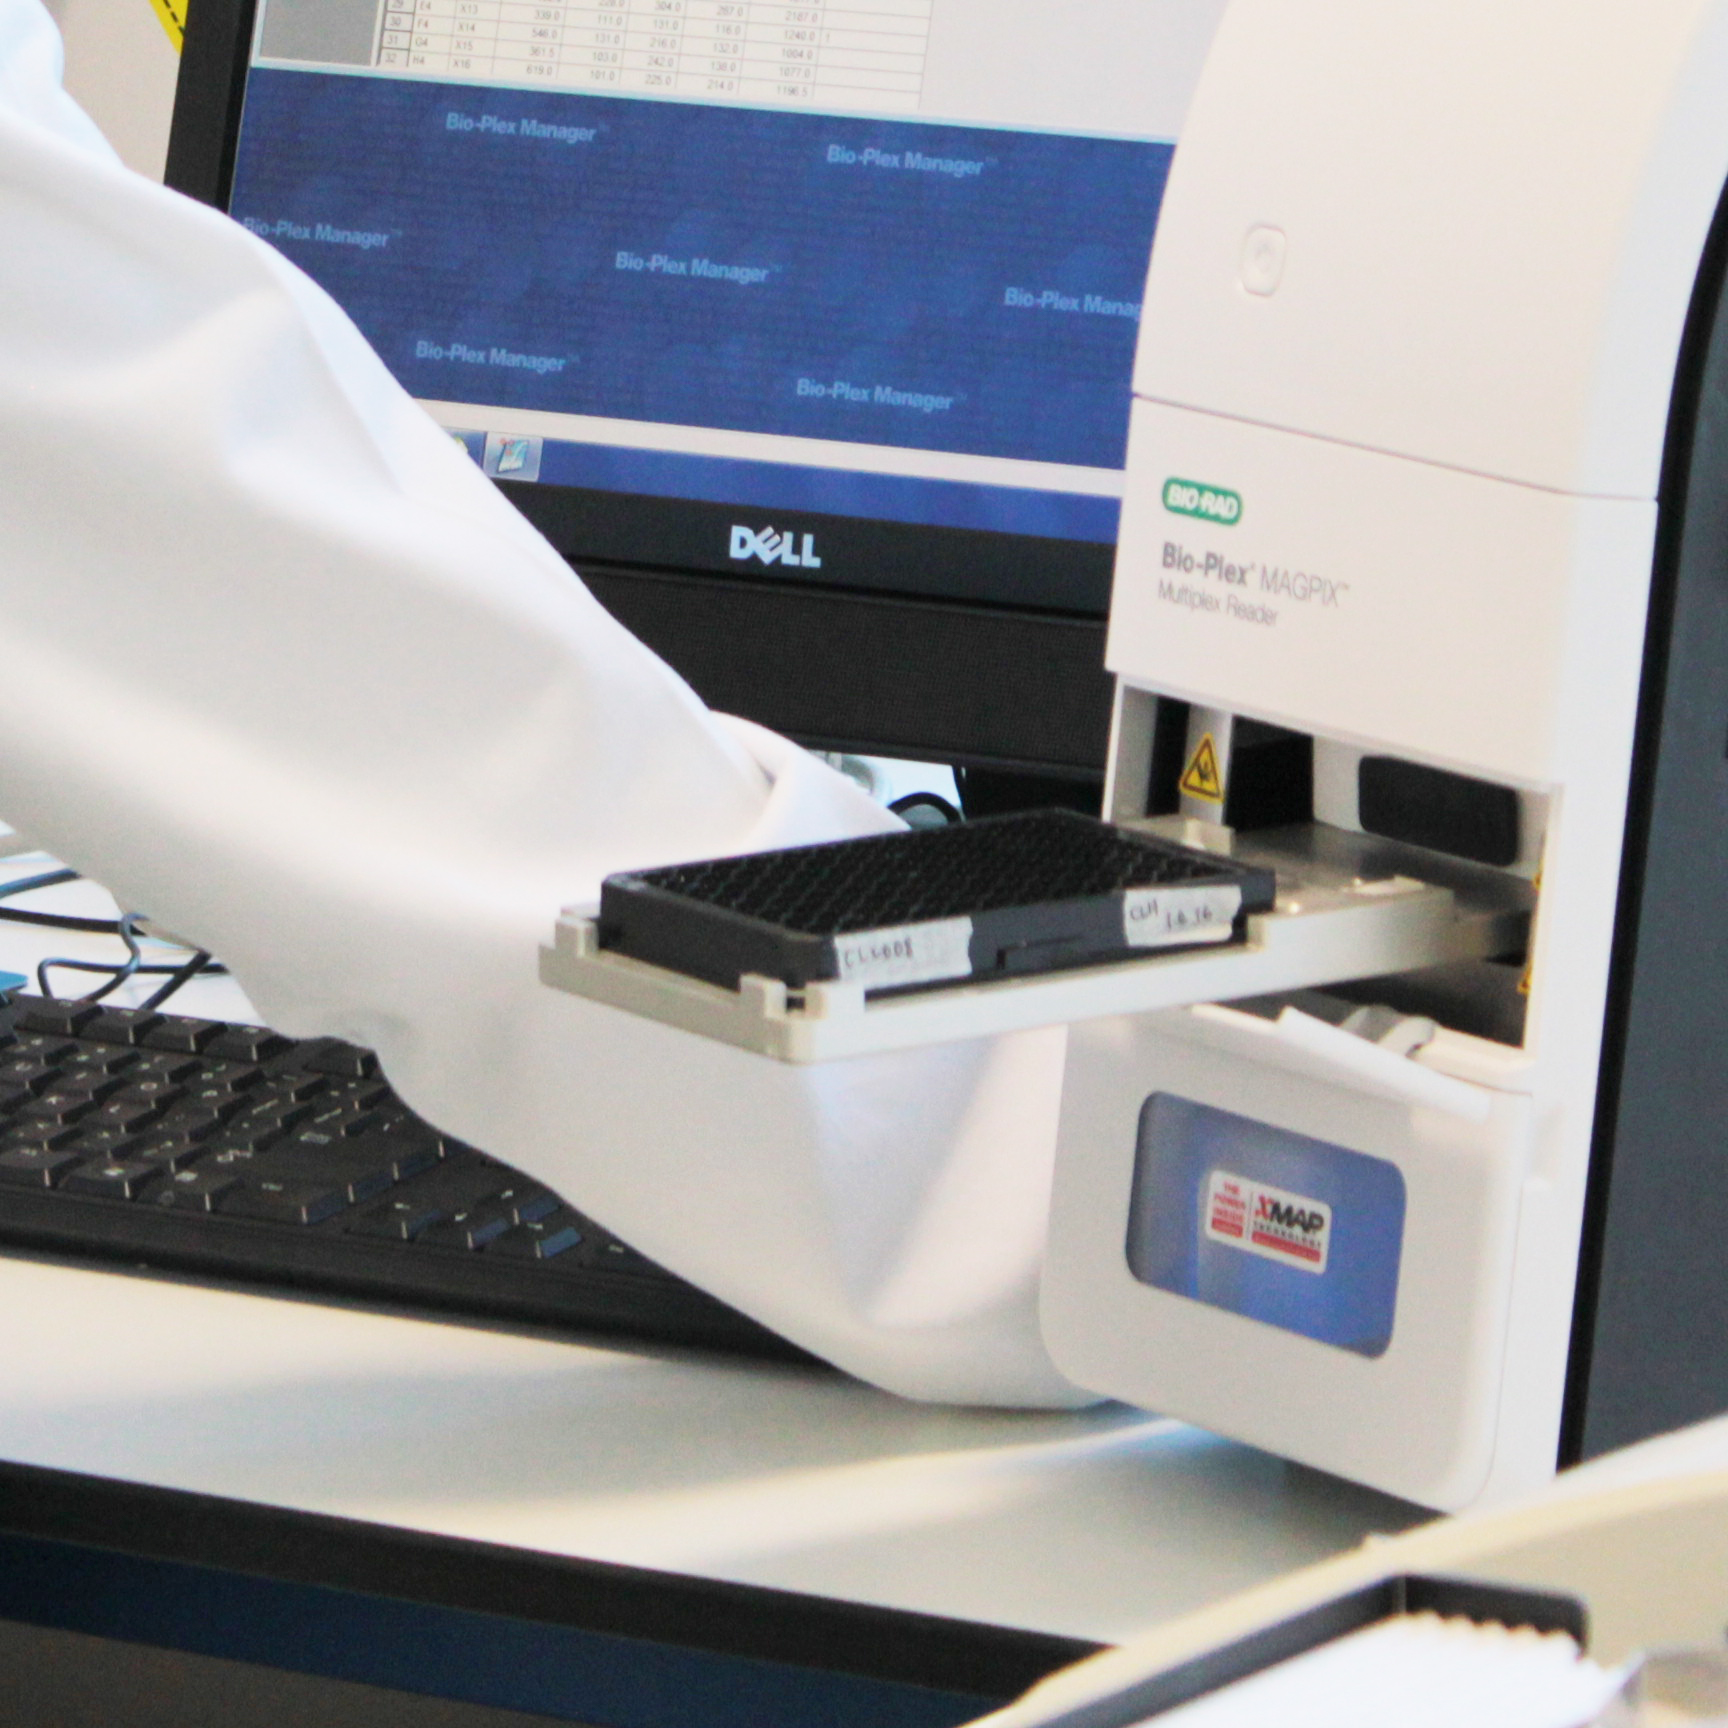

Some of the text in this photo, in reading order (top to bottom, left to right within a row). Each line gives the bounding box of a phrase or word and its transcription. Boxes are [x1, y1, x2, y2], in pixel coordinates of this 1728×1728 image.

[1083, 293, 1143, 322] Manag
[728, 523, 821, 570] DELL
[1158, 578, 1278, 627] Multiplex Reader
